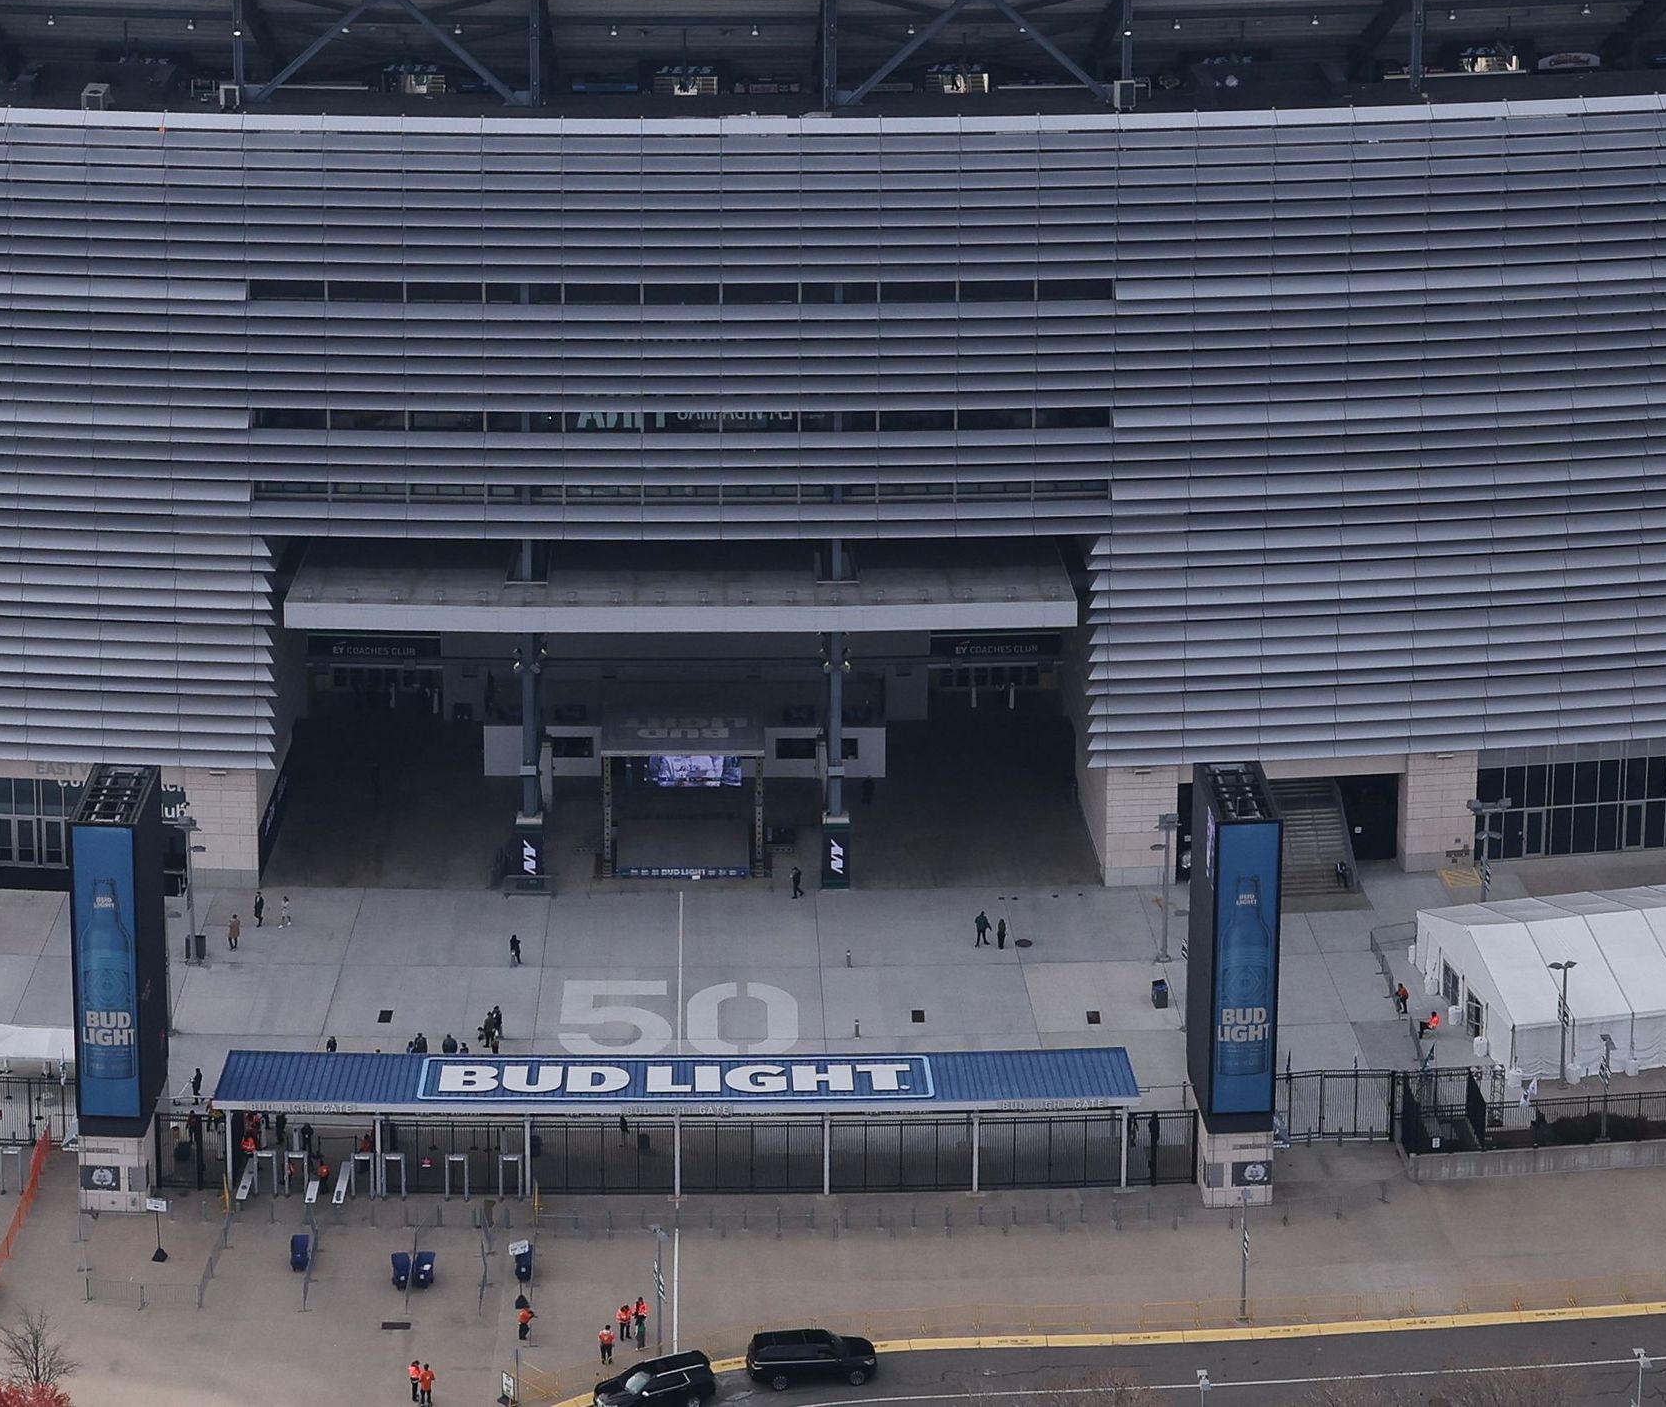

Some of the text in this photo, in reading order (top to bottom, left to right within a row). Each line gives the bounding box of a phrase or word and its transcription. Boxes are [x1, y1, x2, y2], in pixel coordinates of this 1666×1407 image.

[346, 646, 389, 655] COACHES
[391, 647, 416, 656] CLUB
[969, 645, 1013, 654] COACHES
[1013, 644, 1038, 653] CLUB
[36, 762, 77, 776] EAST
[96, 896, 113, 904] BUD
[1238, 893, 1255, 901] BUD
[85, 1010, 132, 1029] BUD
[558, 980, 800, 1056] 50
[1221, 1007, 1267, 1025] BUD
[83, 1026, 135, 1046] LIGHT
[1218, 1022, 1270, 1043] LIGHT
[439, 1063, 904, 1096] BUD LIGHT
[322, 1104, 353, 1114] GATE
[1074, 1099, 1104, 1109] GATE
[626, 1106, 651, 1115] BUD
[699, 1106, 730, 1115] GATE
